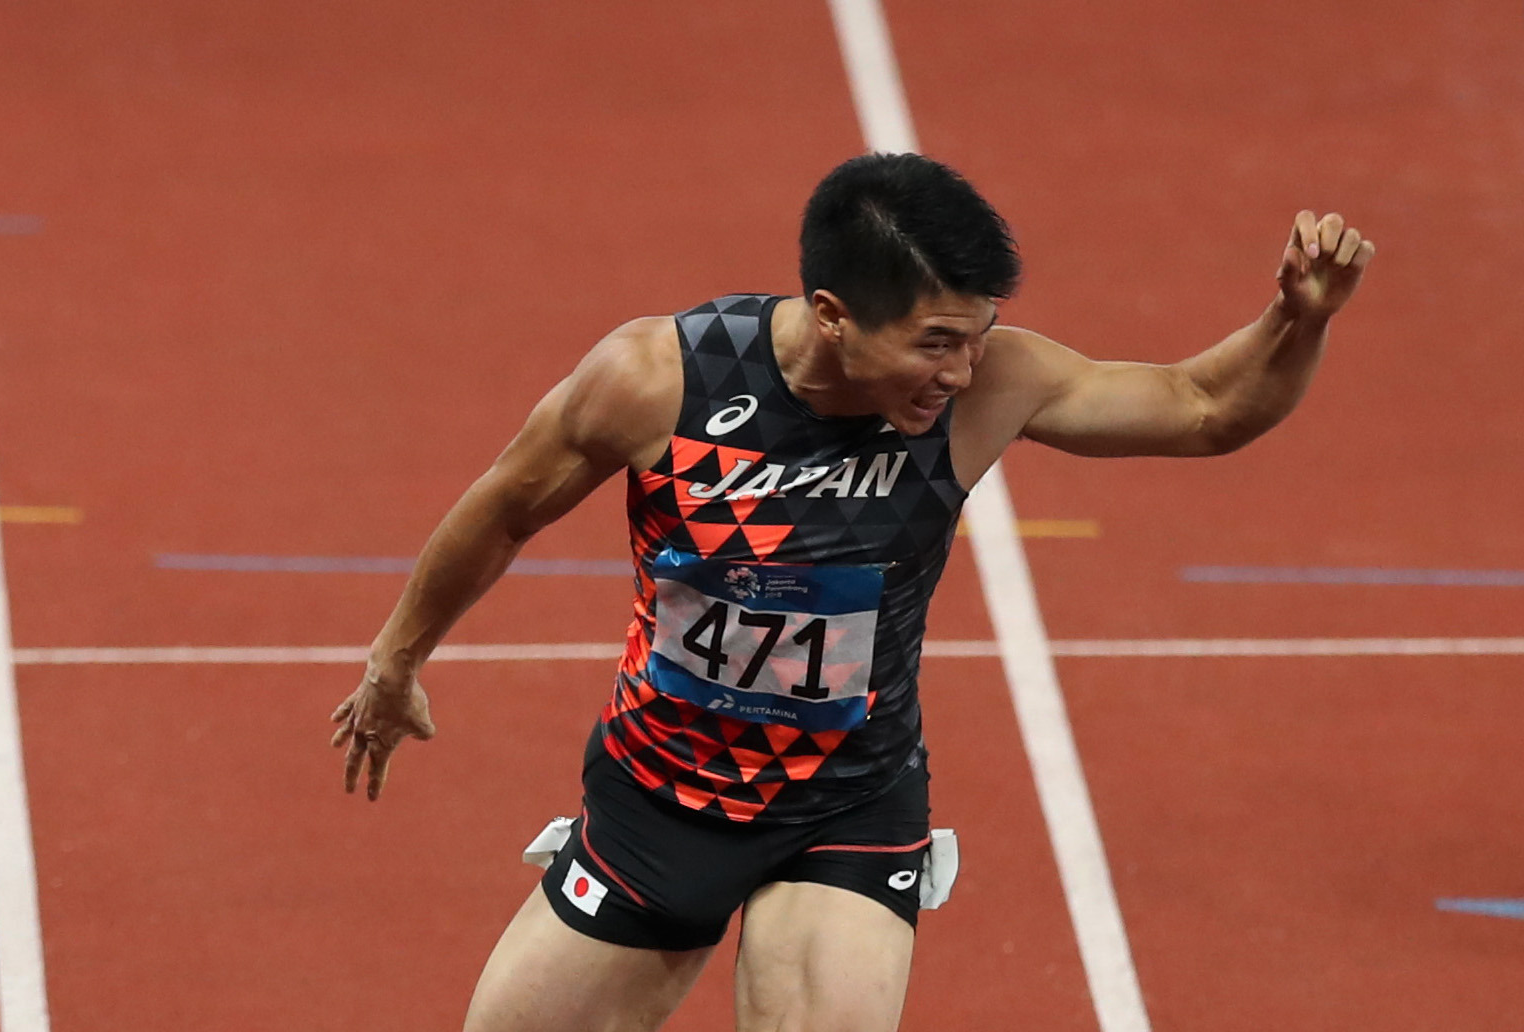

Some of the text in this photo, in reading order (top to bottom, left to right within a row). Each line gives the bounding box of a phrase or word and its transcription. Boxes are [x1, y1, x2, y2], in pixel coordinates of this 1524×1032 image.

[688, 451, 908, 500] JAPAN
[682, 601, 830, 699] 471
[739, 705, 798, 721] PERTAMINA
